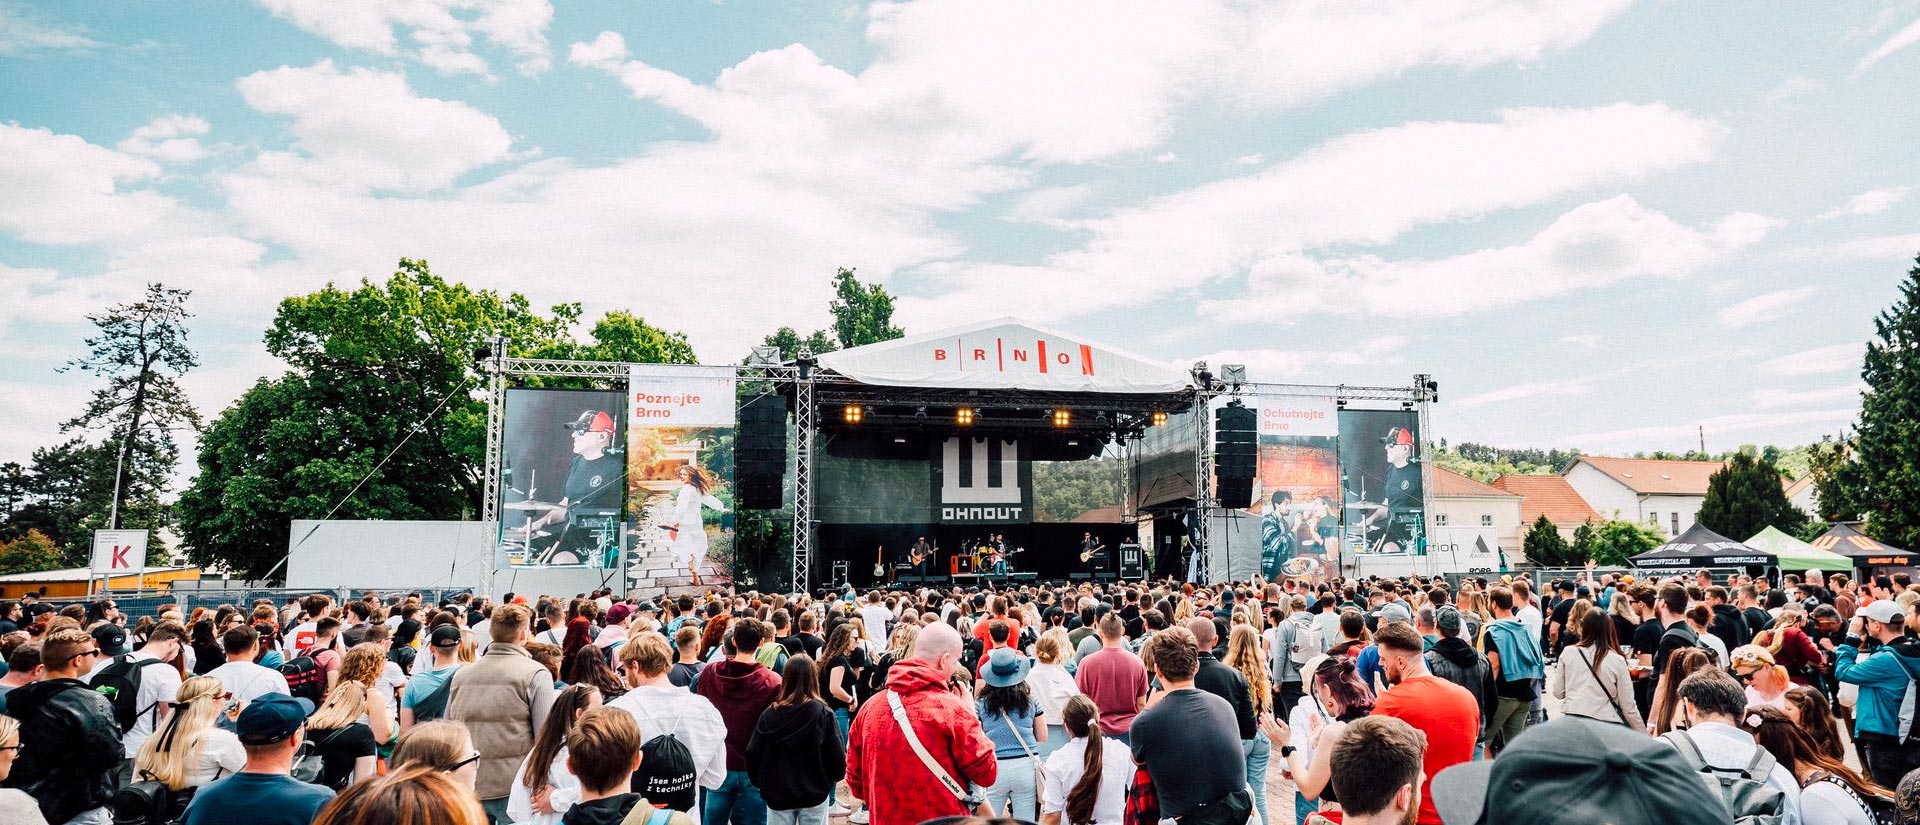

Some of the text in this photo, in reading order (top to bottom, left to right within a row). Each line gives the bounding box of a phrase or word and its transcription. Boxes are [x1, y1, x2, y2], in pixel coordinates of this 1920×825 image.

[636, 392, 701, 407] Poznejte
[636, 407, 671, 418] Brno
[1263, 408, 1325, 420] Ochutnejte
[1264, 421, 1289, 430] Brno
[942, 507, 1022, 520] OHNOUT
[111, 545, 132, 569] K
[648, 776, 669, 785] jsem
[656, 781, 693, 793] techniky
